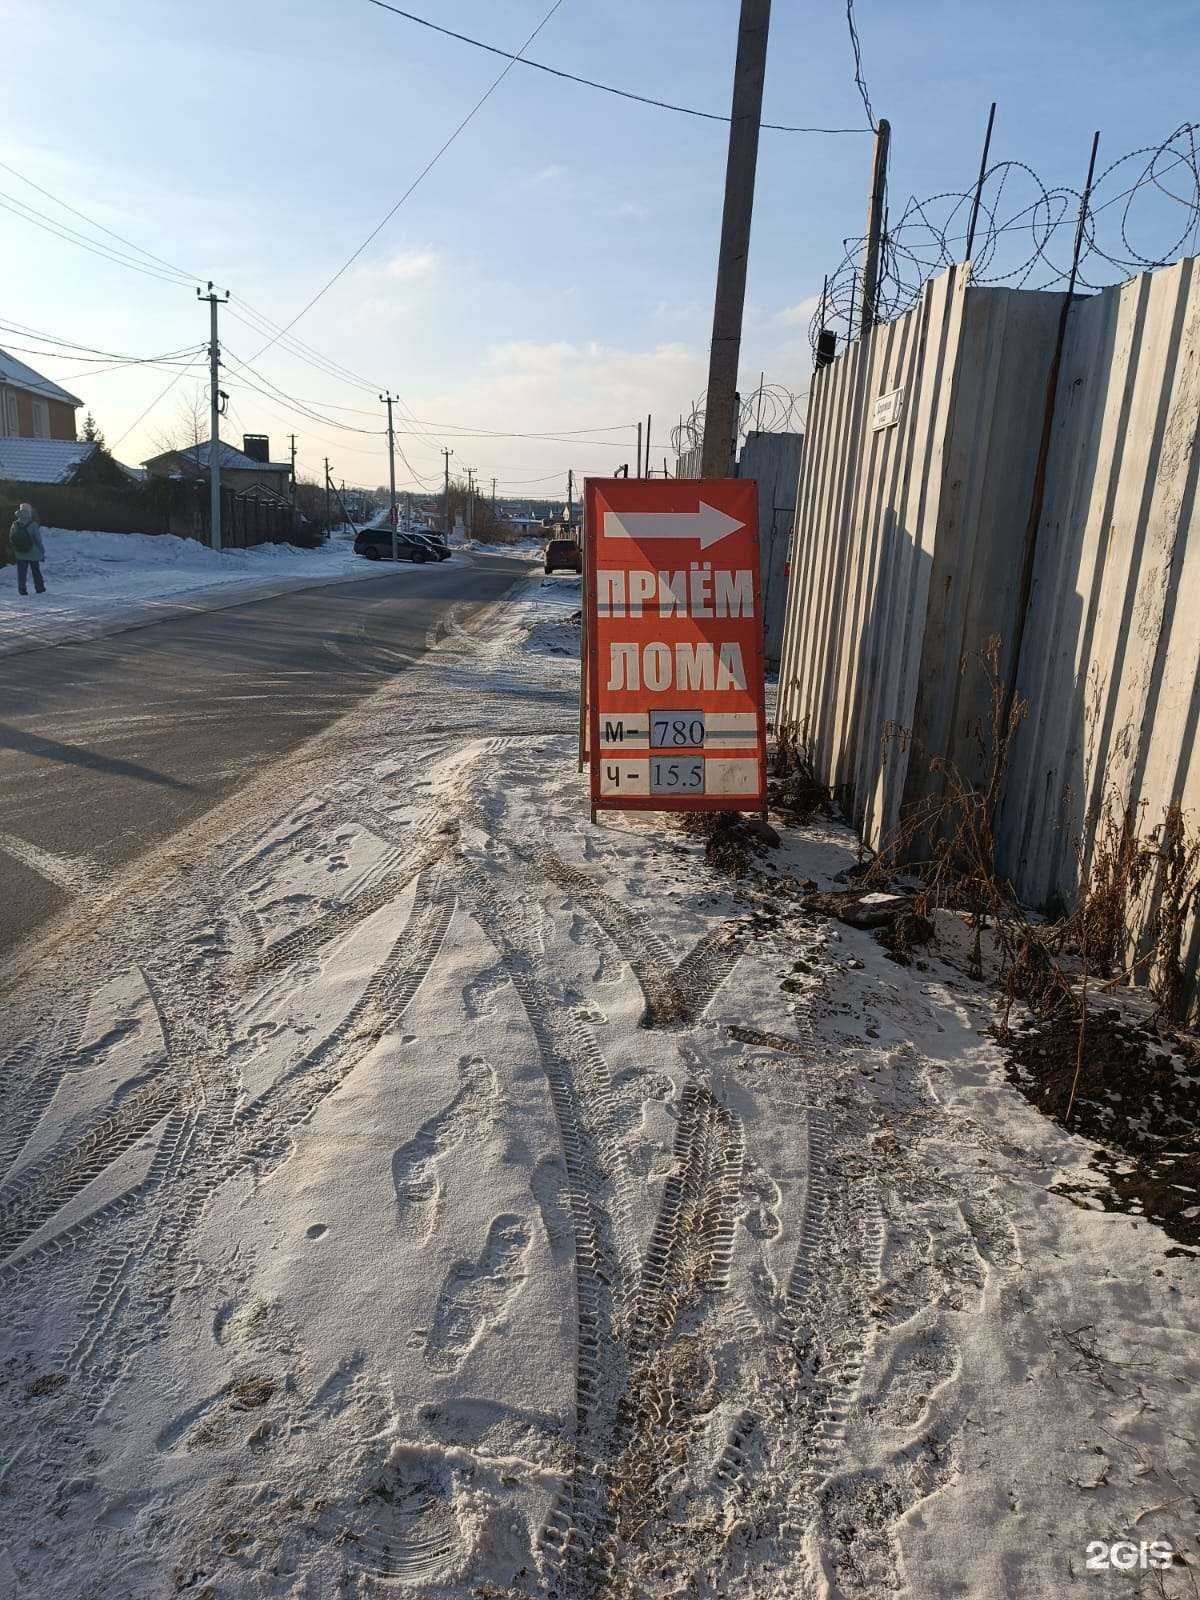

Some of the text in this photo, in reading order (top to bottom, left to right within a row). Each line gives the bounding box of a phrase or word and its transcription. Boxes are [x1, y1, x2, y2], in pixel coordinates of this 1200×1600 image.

[597, 562, 753, 618] ПРИЁМ
[607, 642, 747, 692] ЛОМА
[653, 721, 705, 746] 780
[653, 765, 703, 787] 15.5
